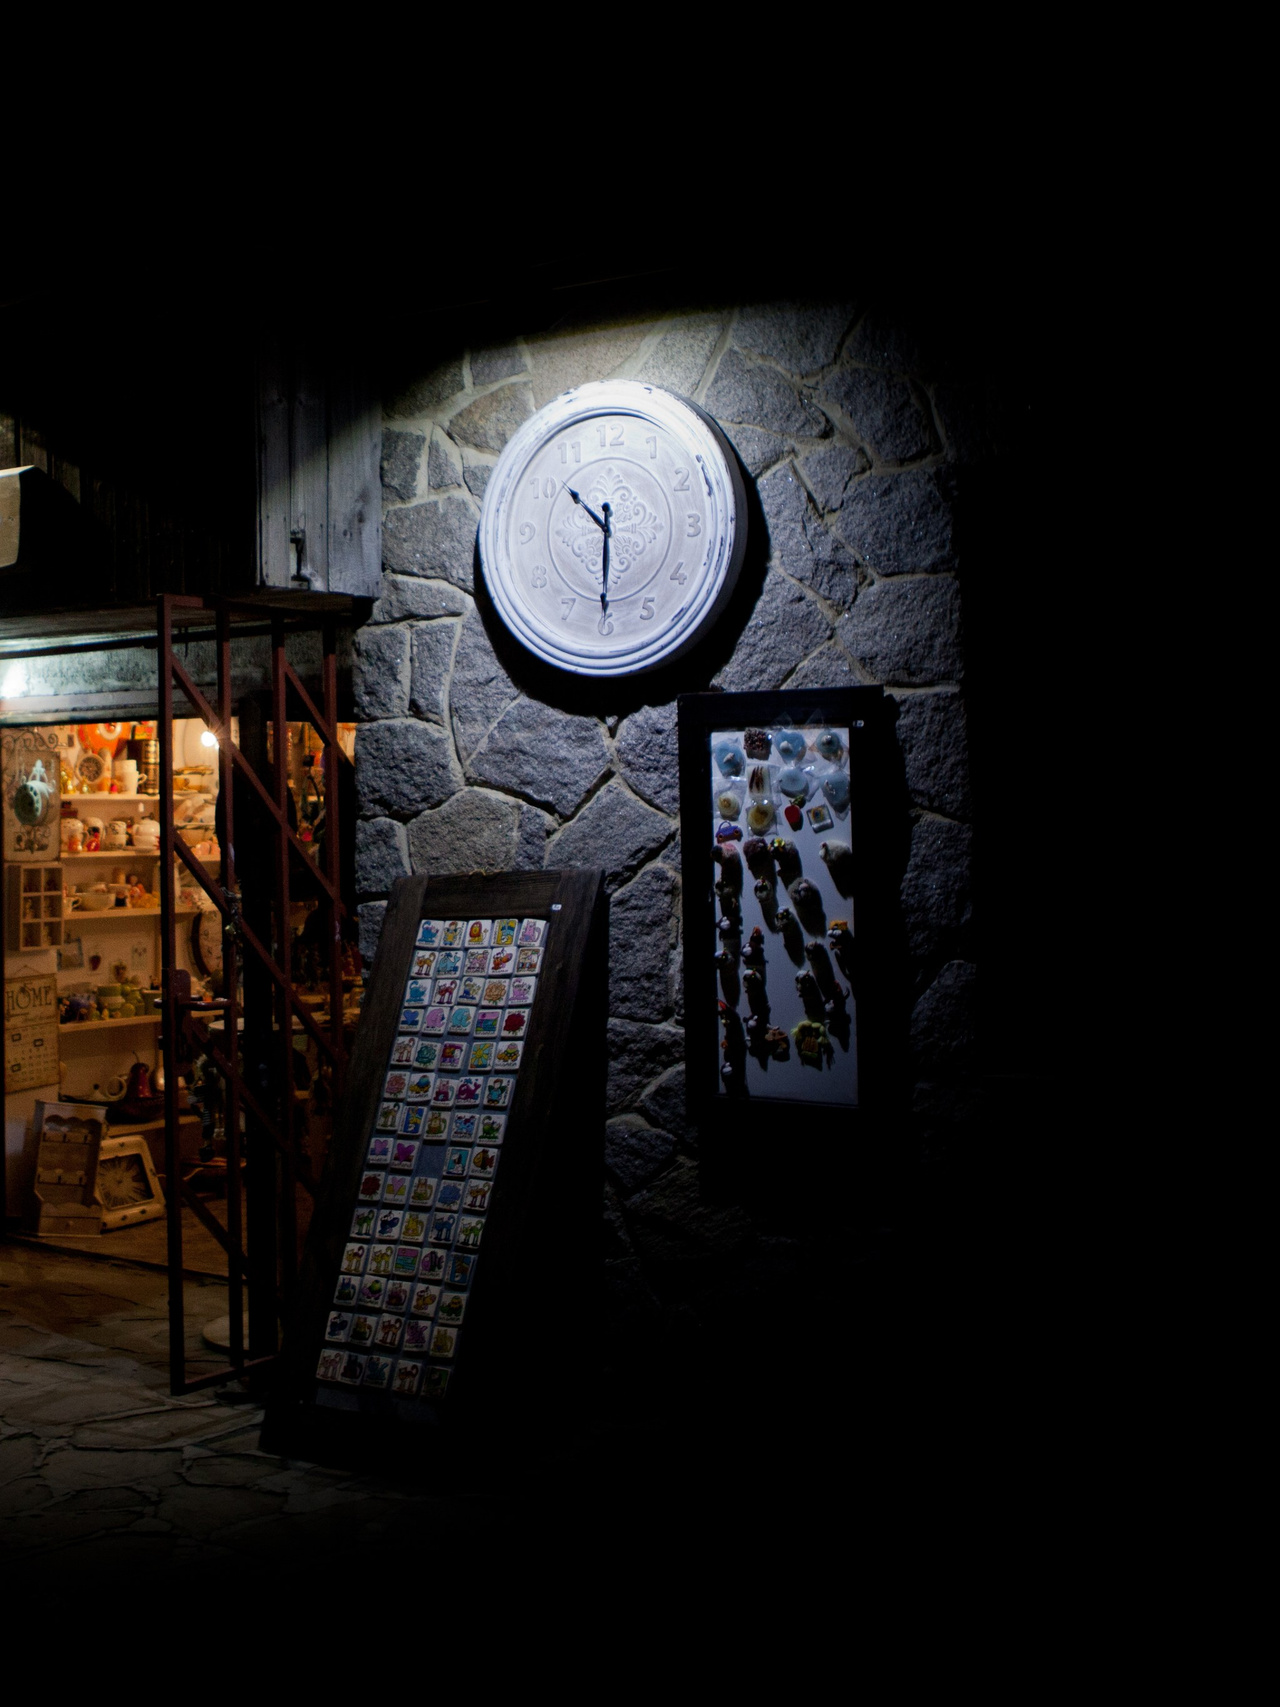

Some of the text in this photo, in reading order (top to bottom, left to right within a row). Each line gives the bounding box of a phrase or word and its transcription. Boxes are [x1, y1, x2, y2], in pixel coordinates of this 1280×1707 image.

[596, 424, 625, 447] 12
[558, 441, 581, 464] 11
[646, 436, 658, 459] 1
[529, 476, 557, 499] 10
[674, 467, 690, 491] 2
[520, 521, 536, 544] 9
[687, 513, 701, 537] 3
[531, 565, 548, 588] 8
[670, 561, 687, 585] 4
[561, 597, 576, 620] 7
[640, 597, 655, 620] 5
[597, 612, 614, 636] 6
[5, 985, 52, 1010] HOME
